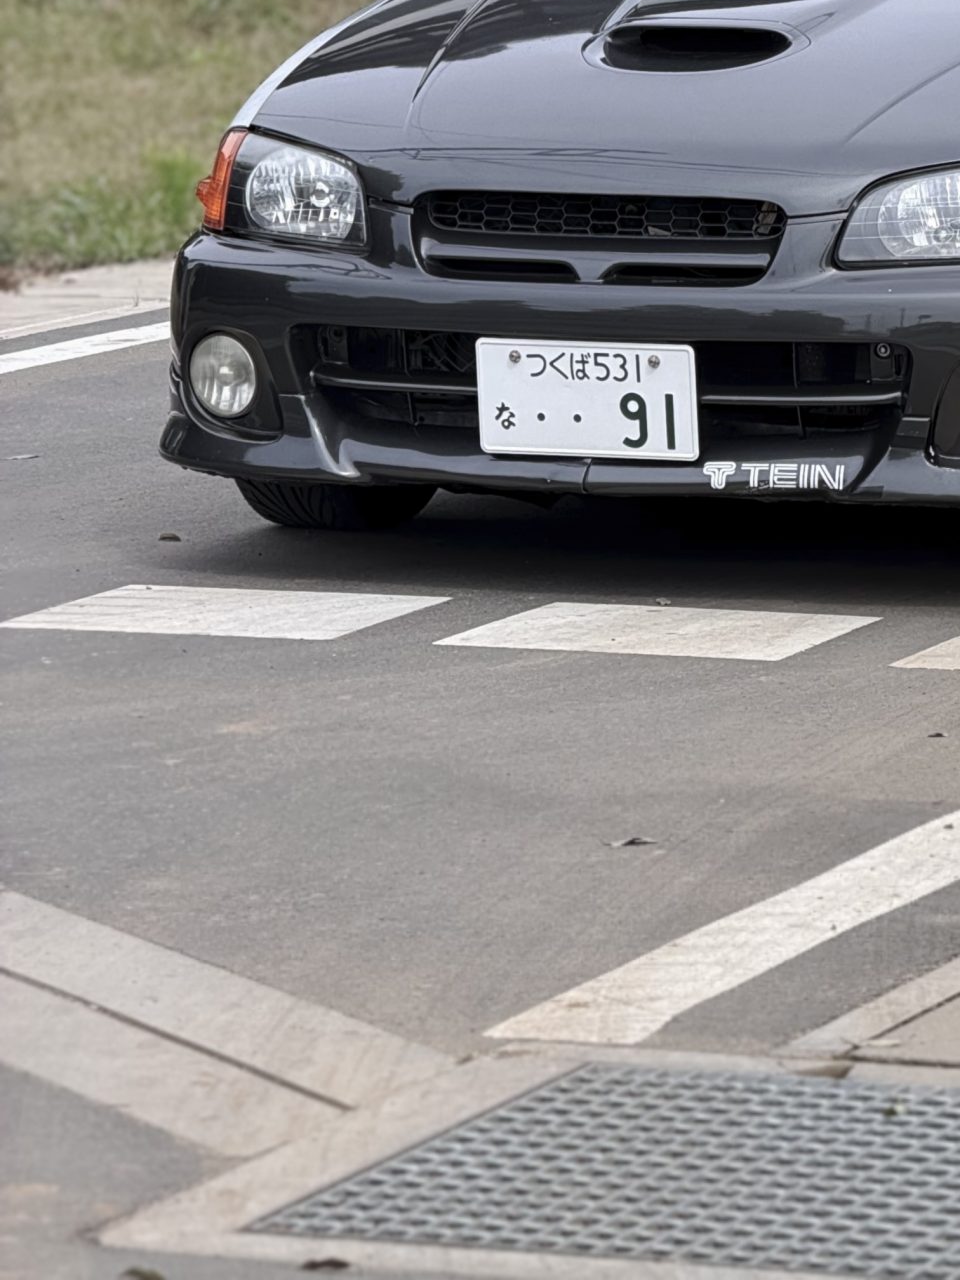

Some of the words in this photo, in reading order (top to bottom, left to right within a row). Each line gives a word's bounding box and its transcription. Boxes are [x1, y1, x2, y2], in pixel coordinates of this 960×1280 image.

[526, 352, 641, 383] つくば531
[619, 392, 676, 451] 91
[741, 462, 845, 490] TEIN
